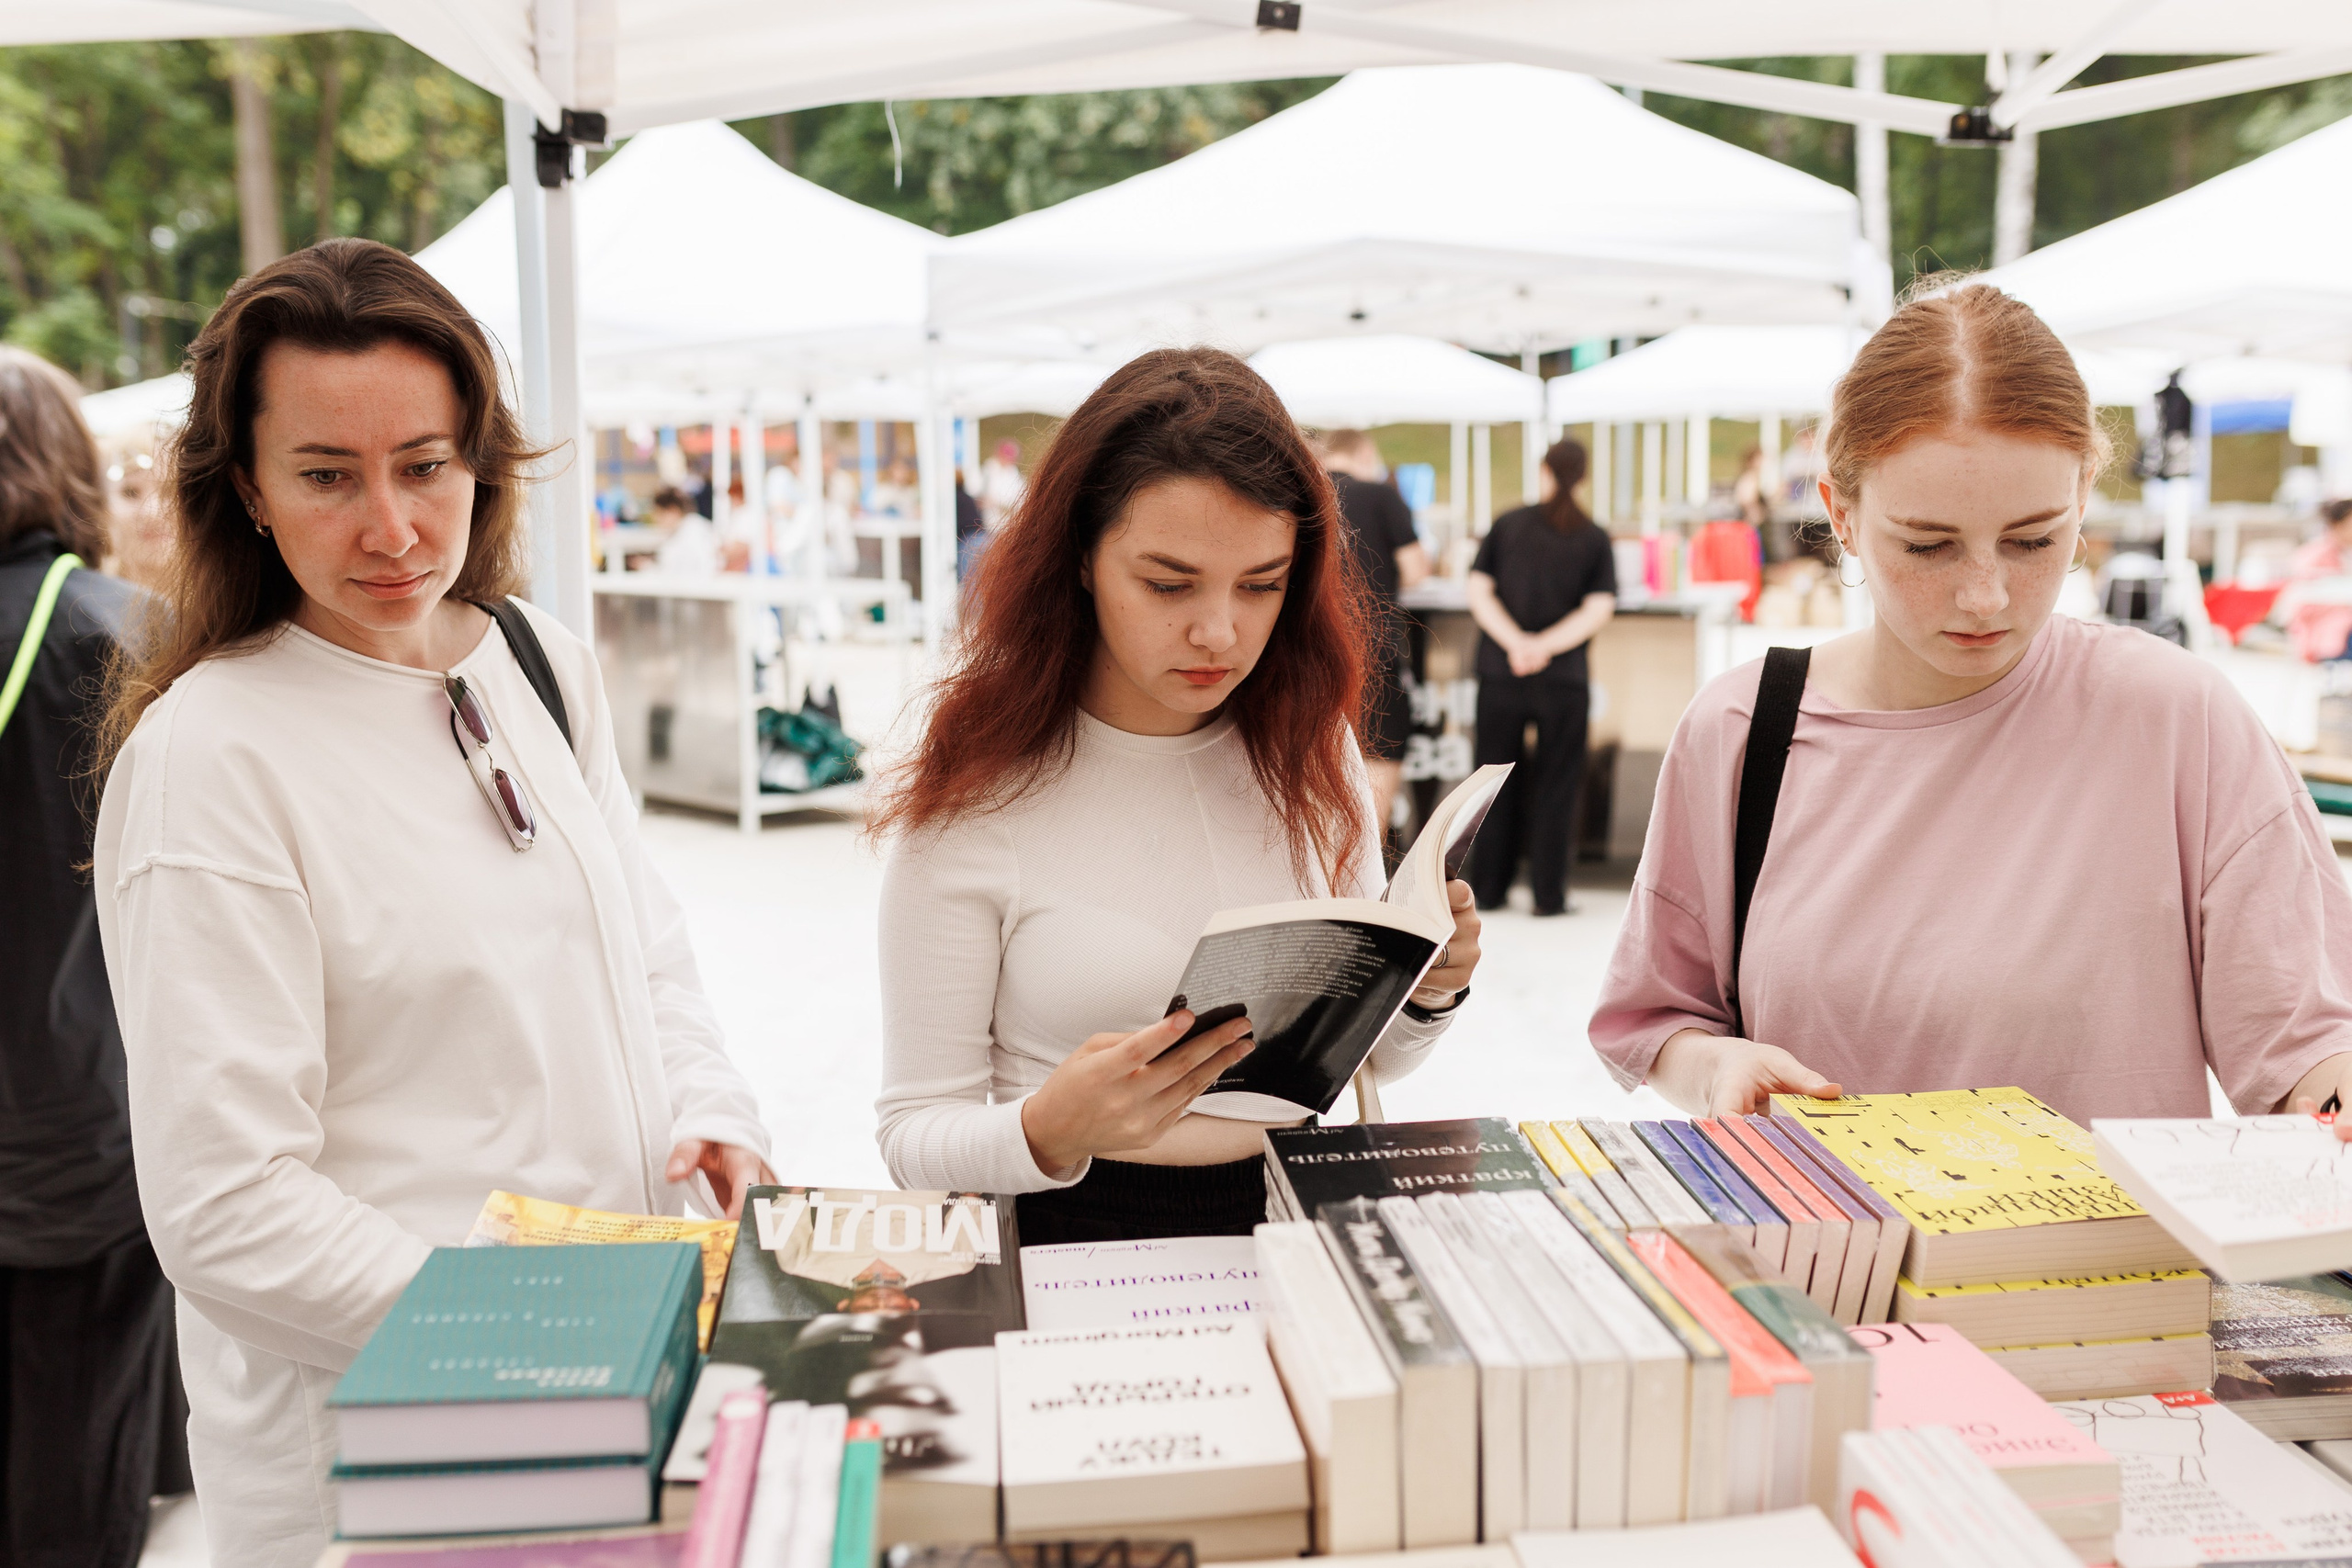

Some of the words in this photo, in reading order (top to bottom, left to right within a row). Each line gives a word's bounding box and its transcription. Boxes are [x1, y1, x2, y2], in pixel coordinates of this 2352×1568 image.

[1288, 1142, 1512, 1165] путеводитель
[1392, 1168, 1533, 1190] краткий
[1984, 1183, 2126, 1205] УЗЫКИ
[753, 1191, 1002, 1254] МОДА
[1034, 1268, 1259, 1291] путеводитель
